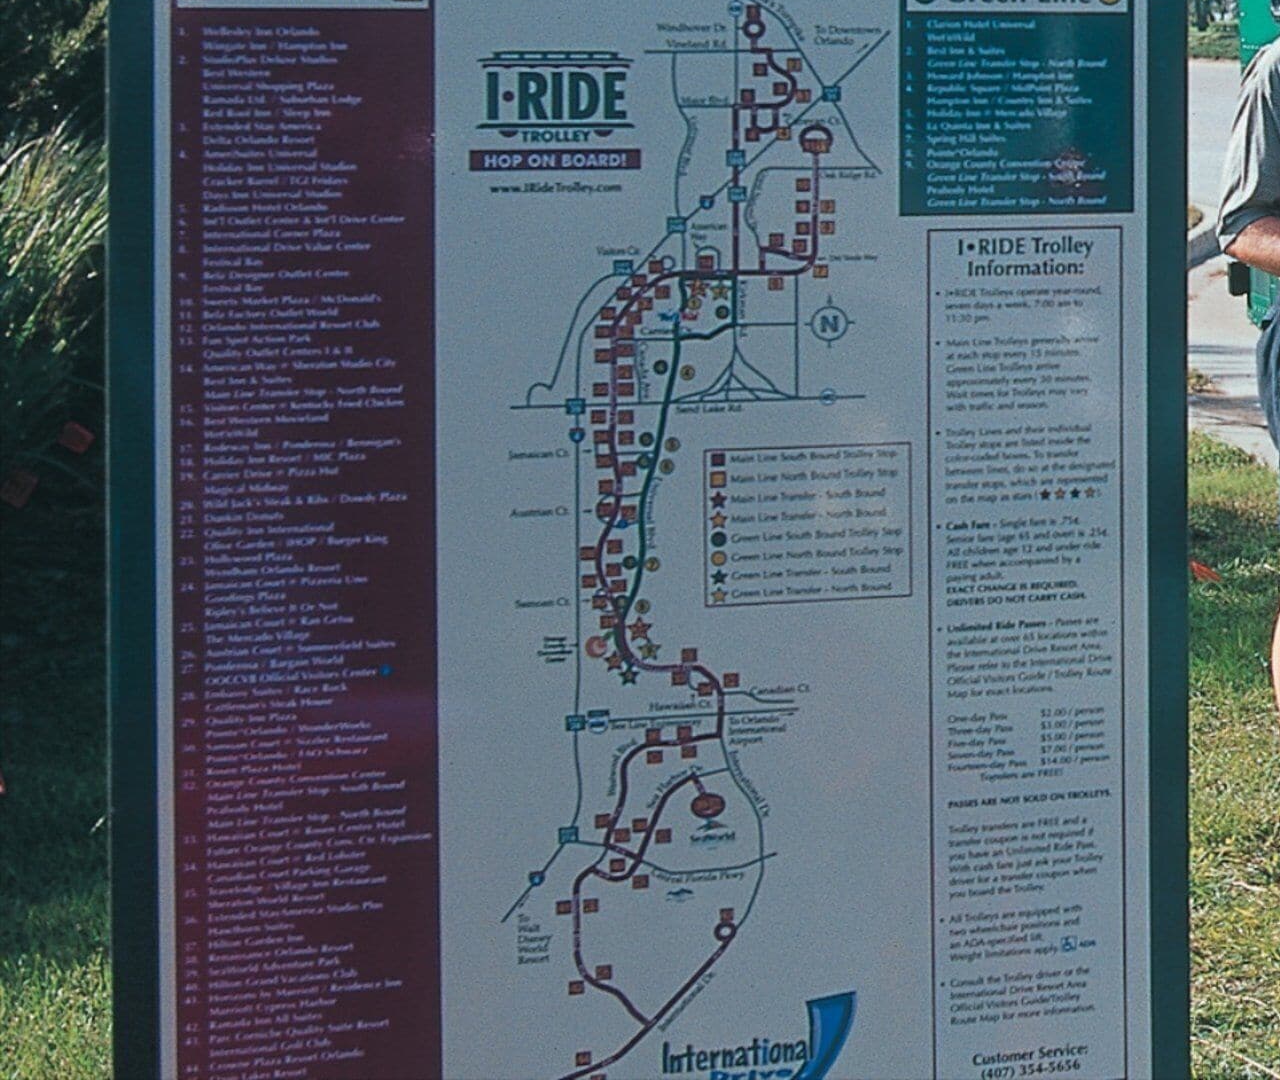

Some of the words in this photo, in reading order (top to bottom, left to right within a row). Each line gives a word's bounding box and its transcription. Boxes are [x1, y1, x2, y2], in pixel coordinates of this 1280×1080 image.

[521, 130, 590, 142] TROLLEY
[484, 154, 522, 167] HOP
[528, 154, 555, 167] ON
[561, 153, 627, 167] BOARD!
[1031, 236, 1094, 258] Trolley
[968, 259, 1085, 277] Information:
[821, 315, 839, 332] N
[662, 1036, 813, 1073] International
[972, 1051, 1033, 1066] Customer
[1038, 1044, 1088, 1060] Service:
[1019, 1058, 1081, 1076] 354-5656
